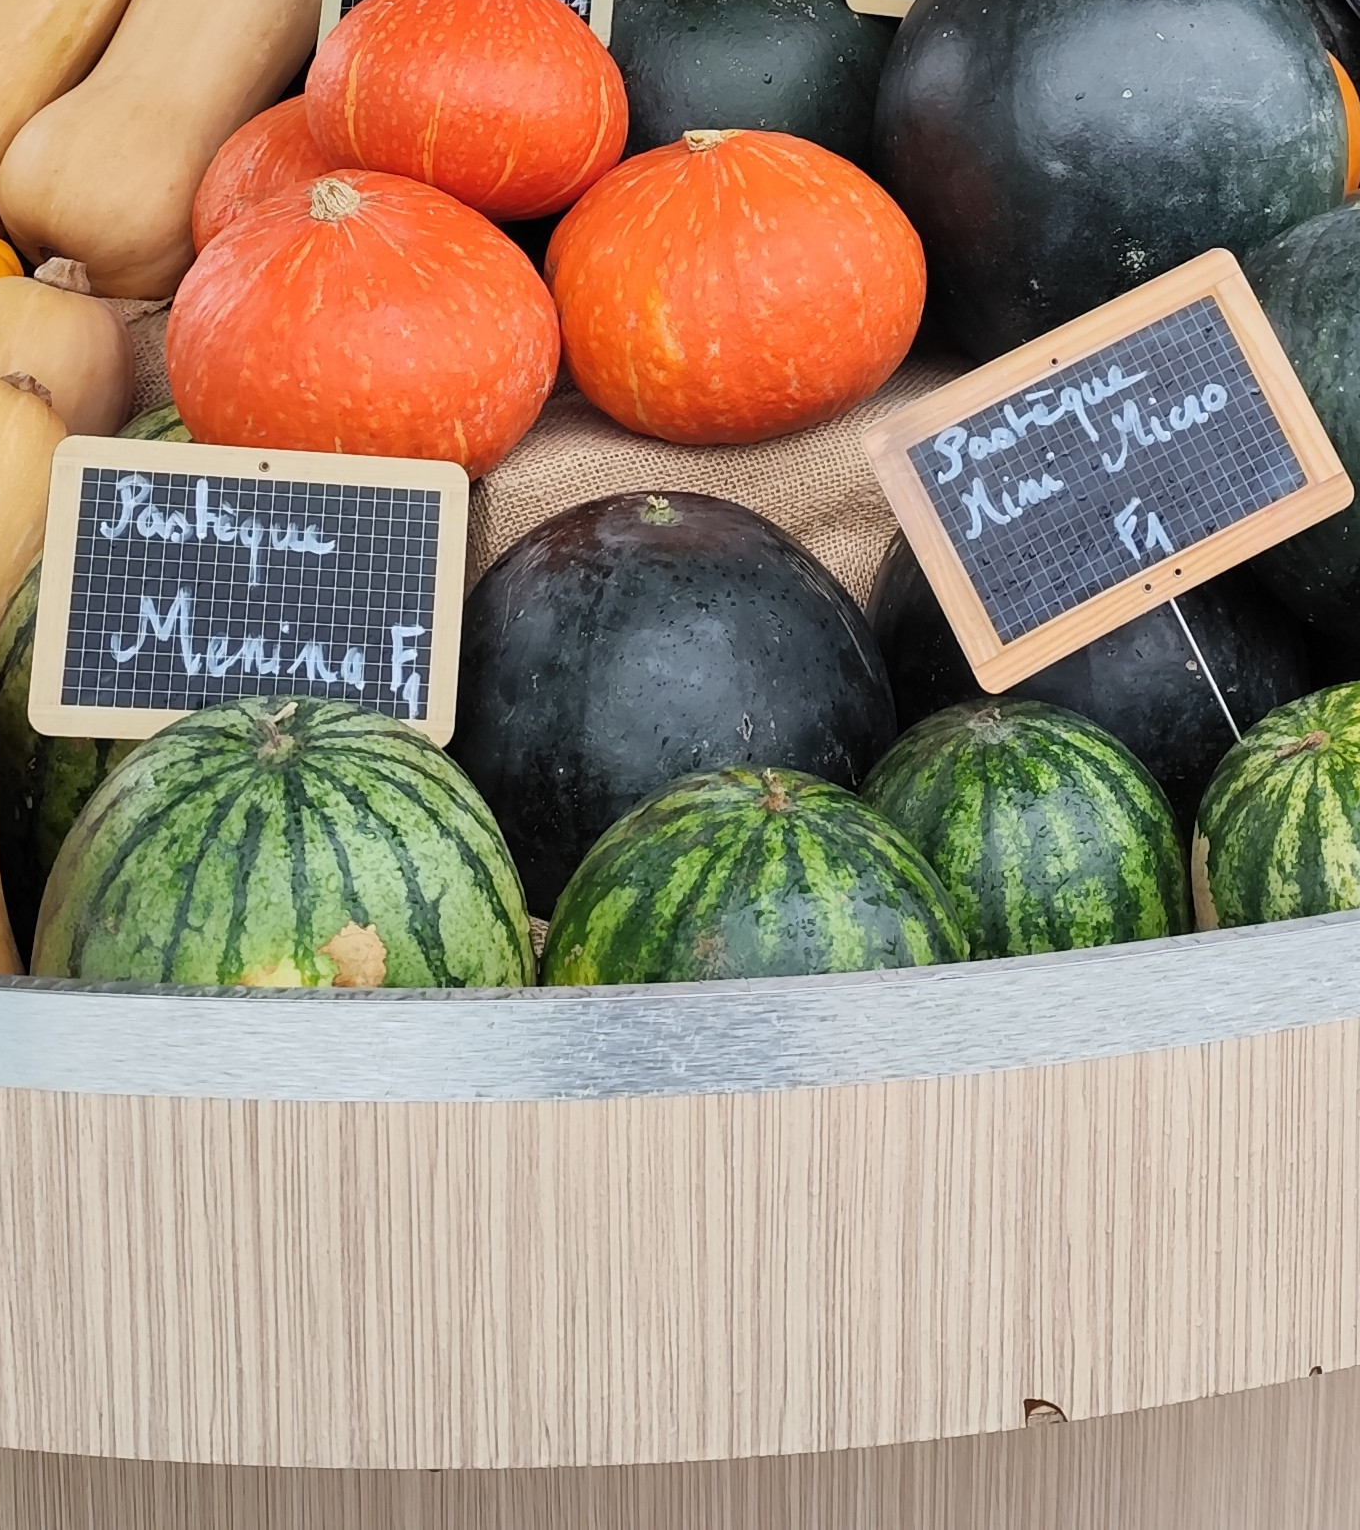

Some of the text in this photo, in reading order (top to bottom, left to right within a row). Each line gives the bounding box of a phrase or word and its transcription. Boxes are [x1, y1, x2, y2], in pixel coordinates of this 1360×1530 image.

[961, 383, 1229, 541] Mini Micro
[1113, 496, 1177, 560] F1
[390, 623, 426, 719] F1
